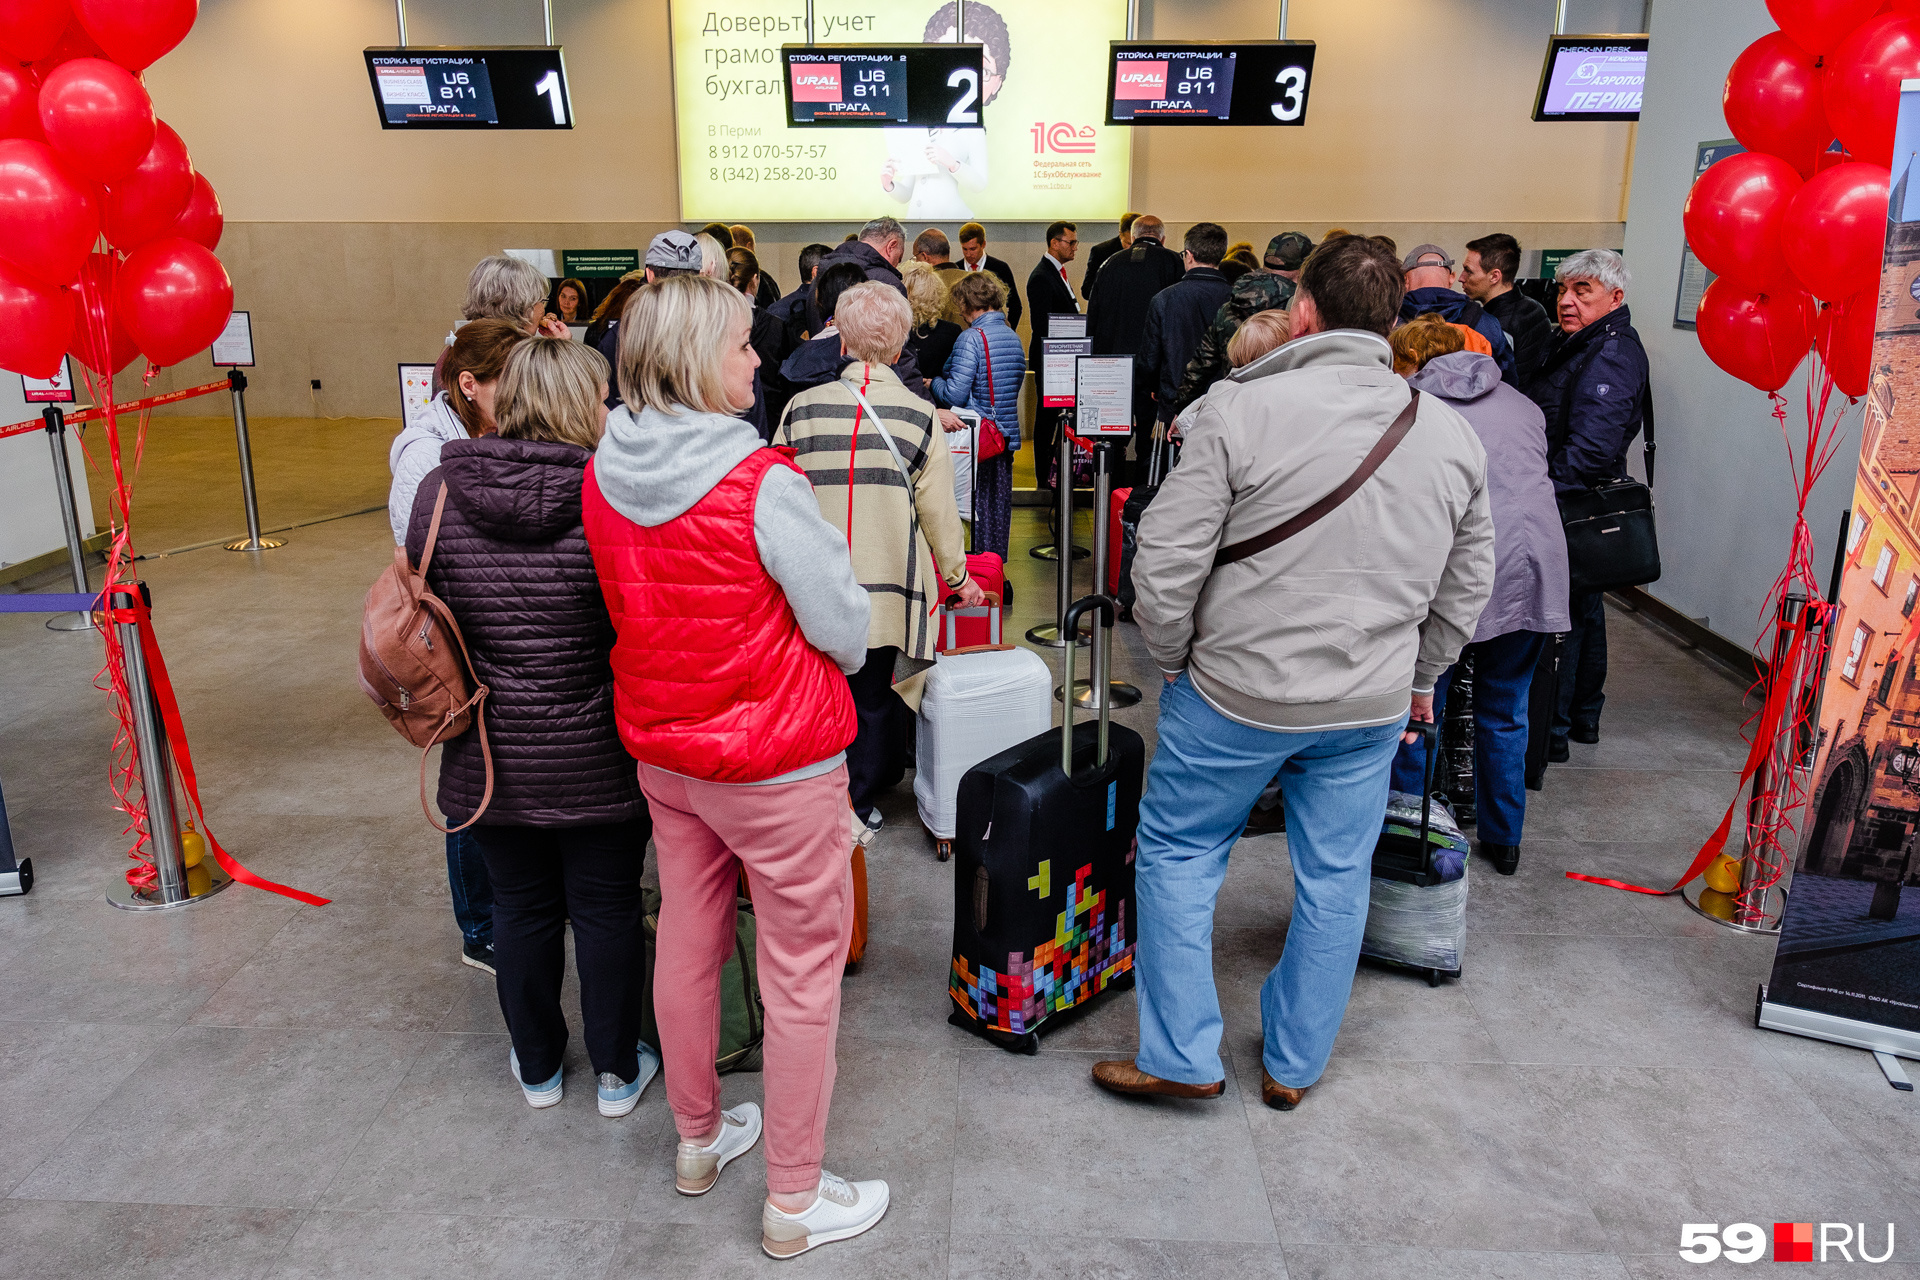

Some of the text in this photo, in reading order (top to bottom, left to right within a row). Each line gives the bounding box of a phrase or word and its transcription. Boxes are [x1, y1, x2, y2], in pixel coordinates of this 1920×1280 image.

[823, 14, 876, 38] учет
[372, 57, 409, 65] СТОЙКА
[789, 54, 826, 62] СТОЙКА
[828, 54, 894, 62] РЕГИСТРАЦИИ
[1116, 51, 1154, 59] СТОЙКА
[1156, 52, 1223, 60] РЕГИСТРАЦИИ
[442, 73, 469, 85] U6
[859, 70, 886, 82] U6
[1120, 73, 1165, 83] URAL
[1185, 67, 1213, 80] U6
[796, 76, 839, 86] URAL
[440, 87, 477, 99] 811
[705, 75, 783, 101] бухгал
[853, 84, 890, 97] 811
[1177, 82, 1216, 95] 811
[535, 70, 567, 125] 1
[946, 68, 979, 124] 2
[1270, 67, 1307, 122] 3
[1150, 100, 1193, 109] ПРАГА
[1564, 92, 1643, 110] ПЕРМЬ
[419, 105, 461, 113] ПРАГА
[829, 103, 871, 112] ПРАГА
[708, 124, 762, 139] В Перми
[709, 145, 827, 159] 8 912 070-57-57
[1033, 160, 1077, 169] Федеральная
[710, 167, 838, 183] 8 (342) 258-20-30
[166, 391, 187, 399] AIRLINES
[117, 401, 140, 410] AIRLINES
[5, 420, 36, 432] AIRLINES
